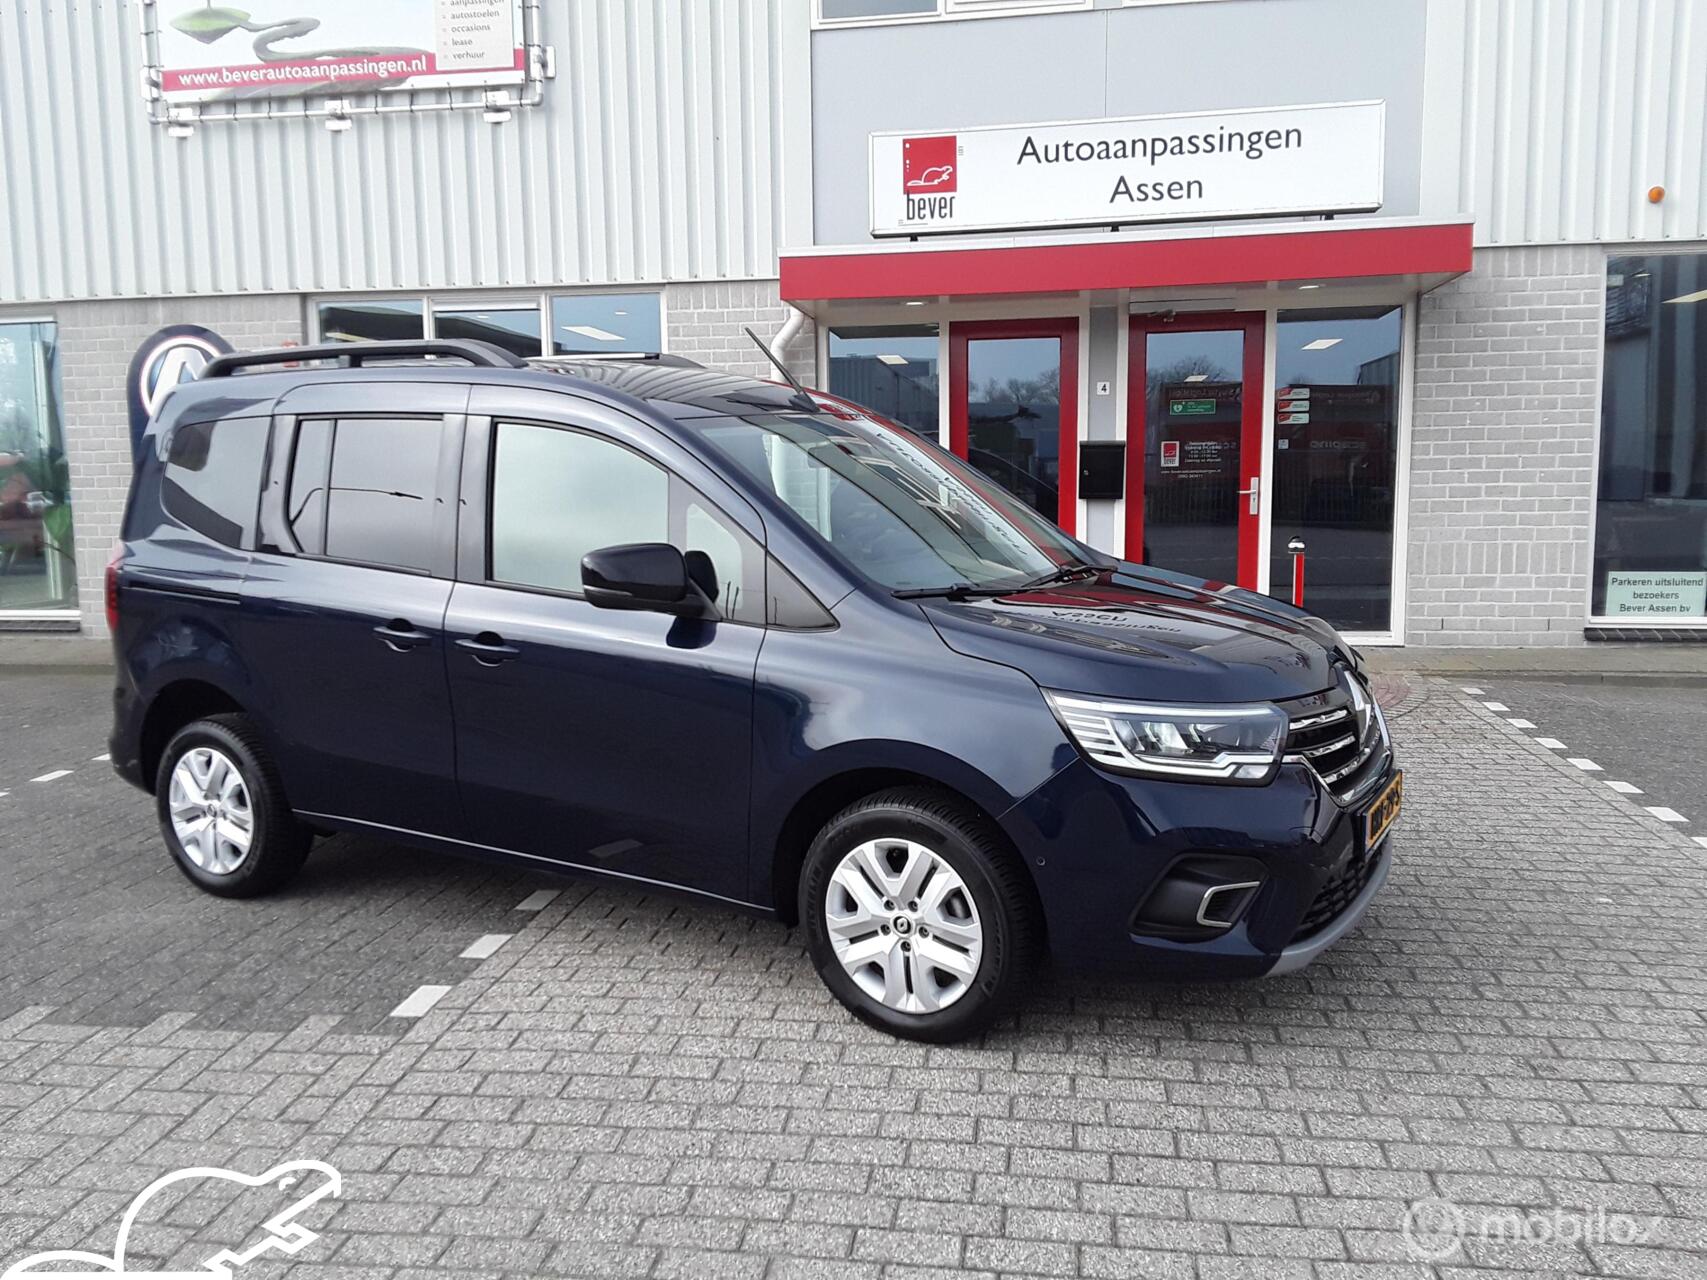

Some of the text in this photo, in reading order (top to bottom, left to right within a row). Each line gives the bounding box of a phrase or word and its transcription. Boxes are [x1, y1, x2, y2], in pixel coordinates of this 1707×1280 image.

[450, 9, 500, 19] autostoelen
[451, 24, 491, 33] occasions
[452, 38, 473, 46] lease
[452, 51, 485, 60] verhuur
[178, 55, 427, 86] www.beverautoaanpassingen.nl
[1016, 126, 1302, 166] Autoaanpassingen
[1109, 175, 1203, 204] Assen
[906, 190, 956, 221] bever
[1101, 383, 1107, 393] 4
[1611, 577, 1704, 586] Parkeren uitsluitend
[1633, 591, 1680, 600] bezoekers
[1619, 603, 1646, 612] Bever
[1648, 604, 1677, 612] Assen
